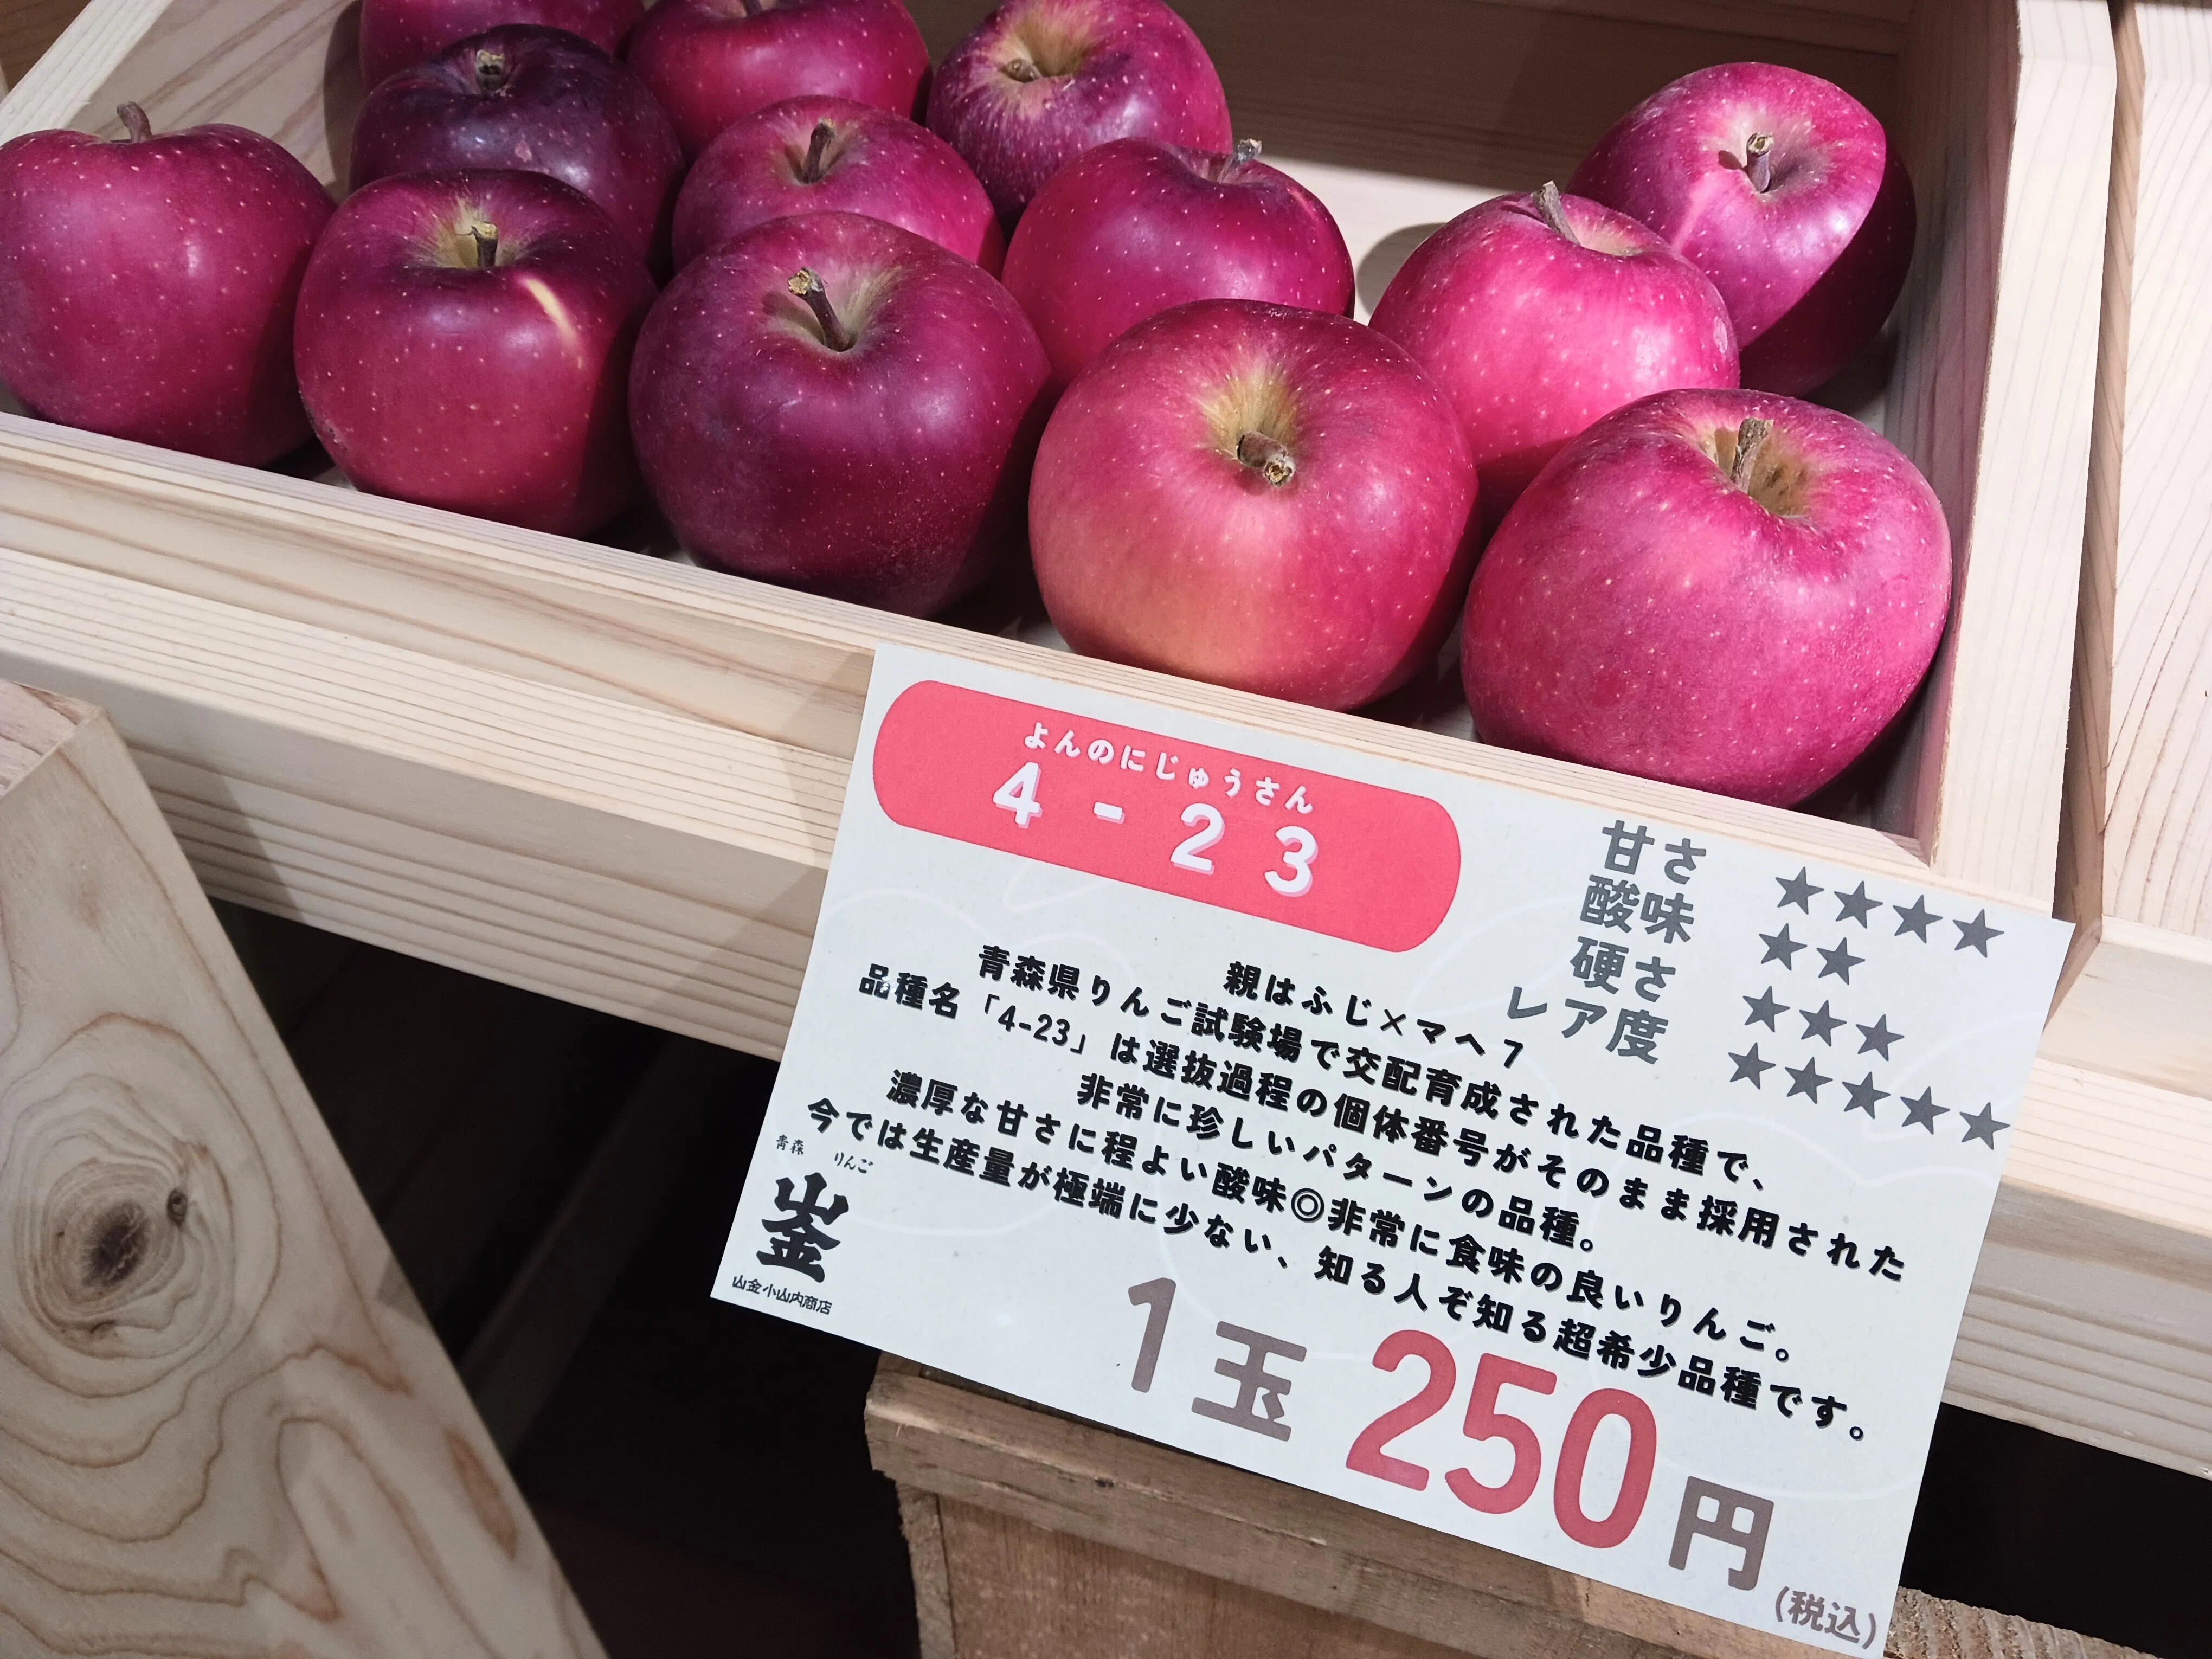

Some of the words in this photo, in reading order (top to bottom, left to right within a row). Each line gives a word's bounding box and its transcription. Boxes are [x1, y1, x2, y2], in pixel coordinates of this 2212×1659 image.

[1023, 722, 1314, 814] よんのにじゅうさん
[1602, 820, 1706, 885] 甘さ
[1579, 874, 1694, 944] 酸味
[1570, 936, 1676, 1003] 硬さ
[1507, 986, 1668, 1065] レア度
[978, 944, 1764, 1191] 青森県りんご試験場で交配育成された品種で、
[776, 1135, 803, 1155] 青森
[834, 1152, 873, 1173] りんご
[1077, 1073, 1594, 1253] 非常に珍しいパターンの品種。
[732, 1275, 832, 1315] 山金小山内商店
[1776, 1586, 1876, 1649] (税込)
